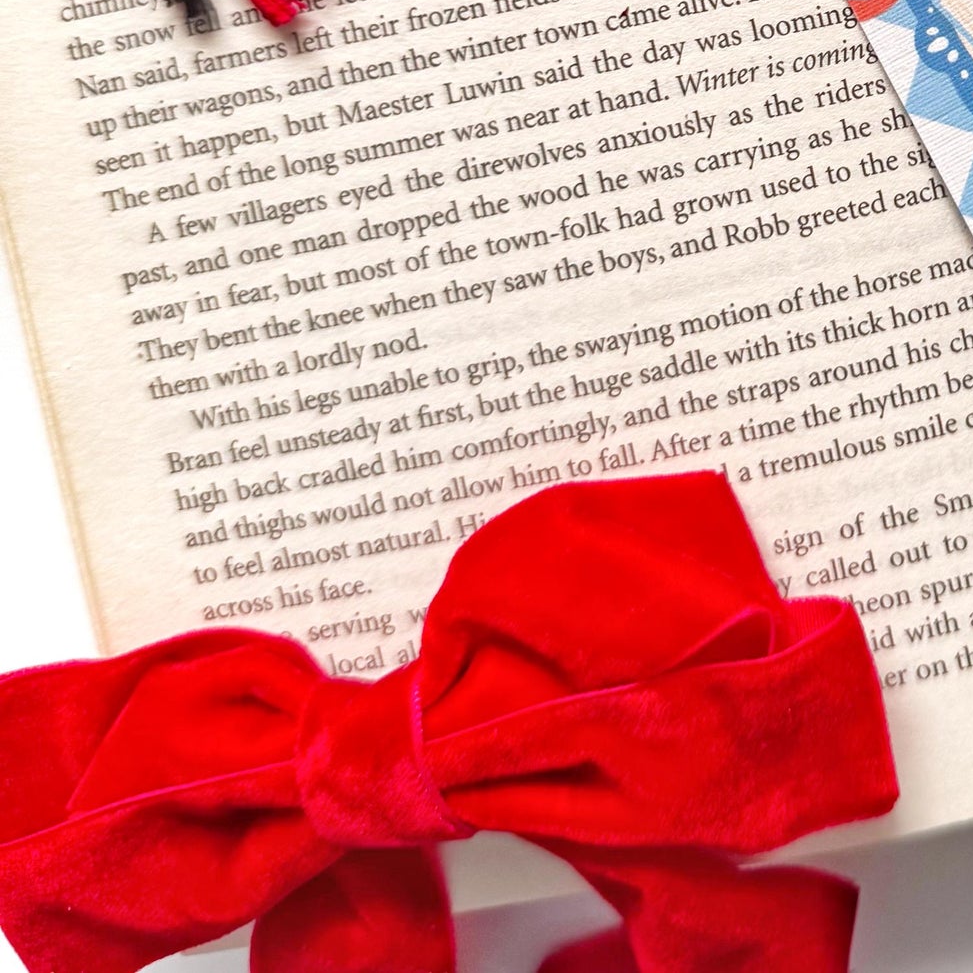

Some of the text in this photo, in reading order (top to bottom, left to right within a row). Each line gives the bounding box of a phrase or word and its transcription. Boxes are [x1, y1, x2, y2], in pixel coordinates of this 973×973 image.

[100, 55, 785, 213] The end of the long summer was near at hand. Winter is
[147, 77, 887, 245] A few villagers eyed the direwolves anxiously as the riders
[147, 327, 429, 401] them with a lordly nod.
[173, 338, 942, 514] high back cradled him comfortingly, and the straps around his
[773, 529, 825, 558] sign
[839, 511, 865, 540] of
[879, 504, 920, 531] the
[202, 578, 373, 621] across his face.
[308, 611, 396, 641] serving
[904, 610, 961, 644] with
[328, 645, 385, 676] local
